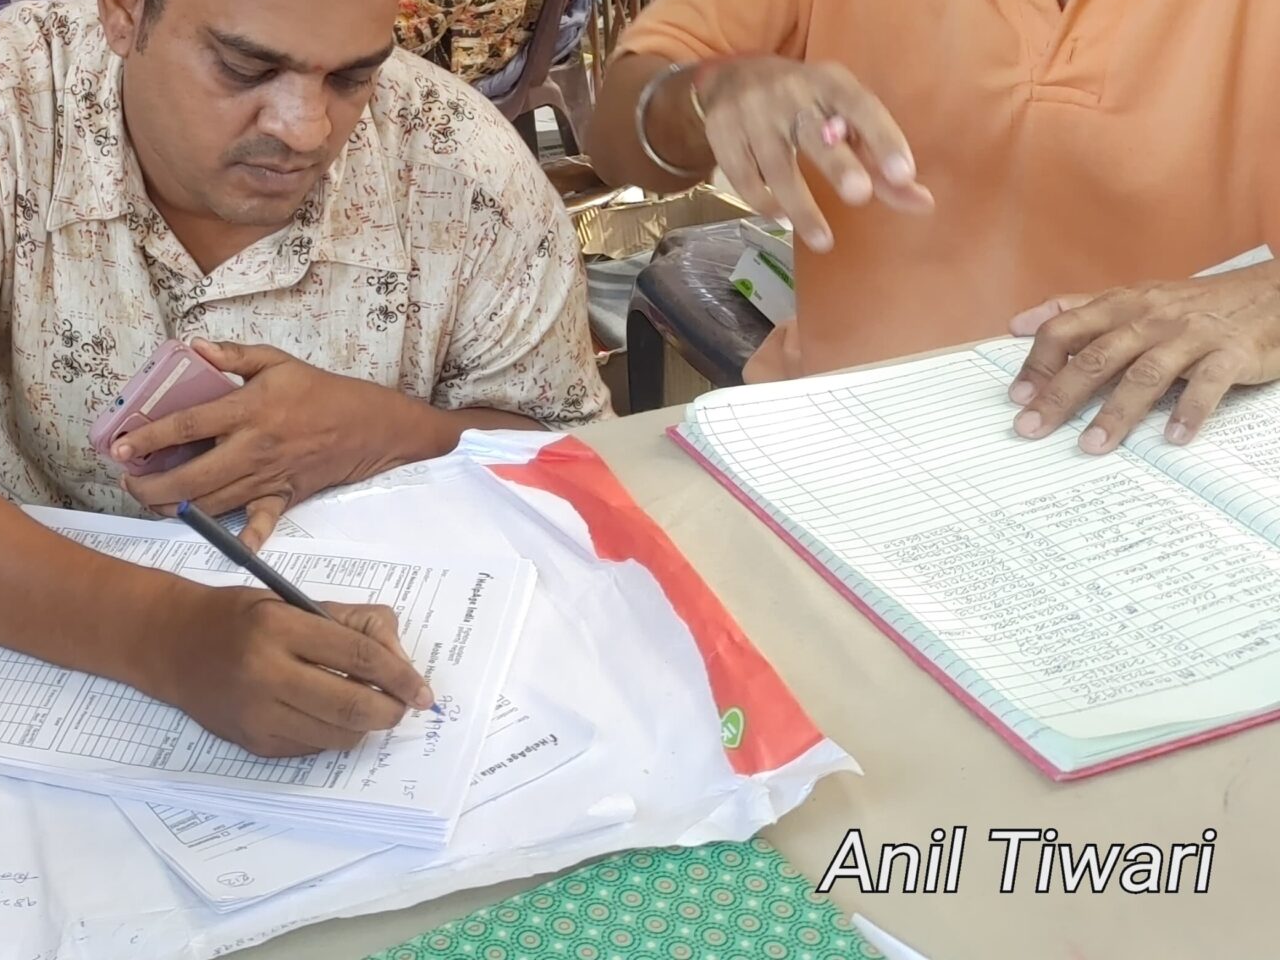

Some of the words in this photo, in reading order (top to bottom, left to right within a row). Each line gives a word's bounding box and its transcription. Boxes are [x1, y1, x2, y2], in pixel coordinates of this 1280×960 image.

[468, 579, 486, 605] HelpAge
[464, 607, 477, 622] India
[428, 642, 443, 663] Mobile
[506, 738, 550, 763] HelpAge
[481, 762, 508, 777] India
